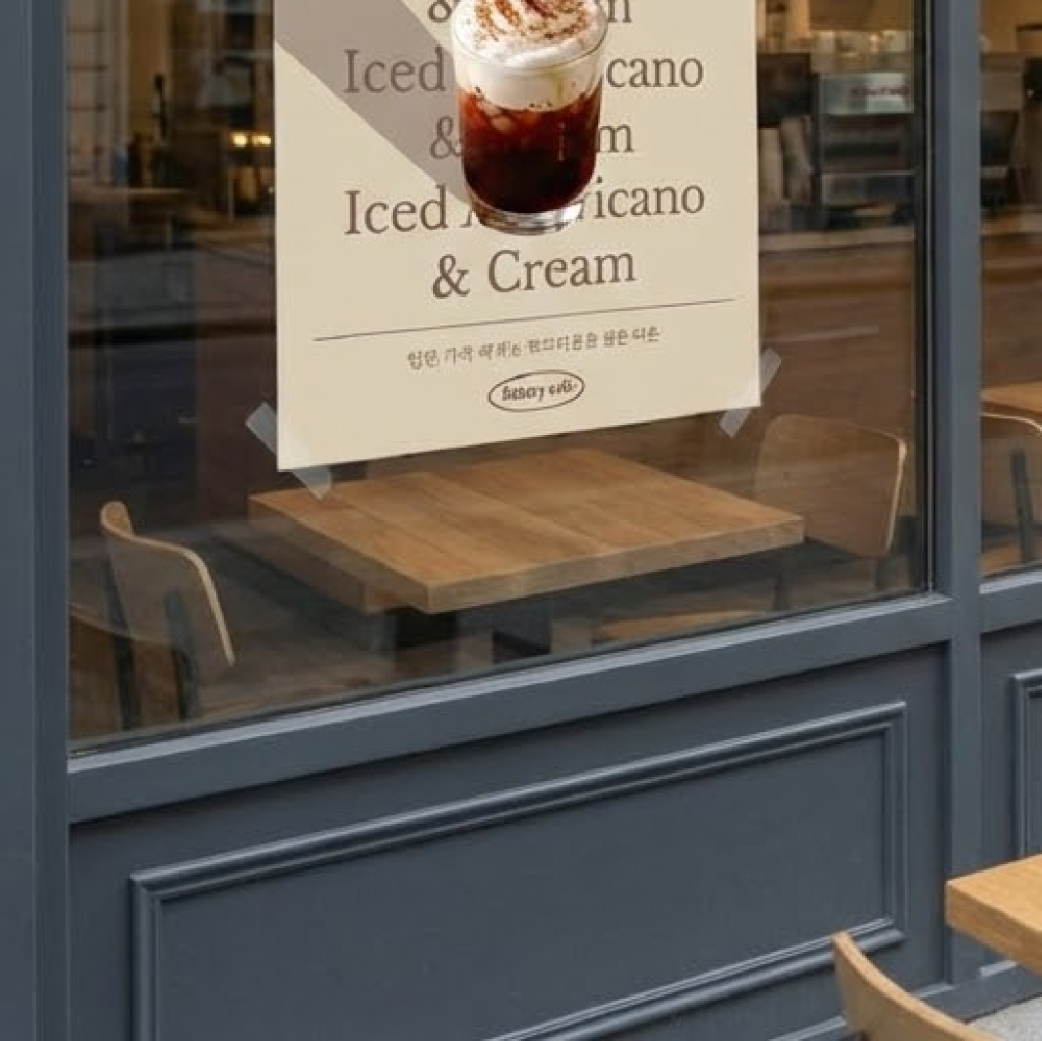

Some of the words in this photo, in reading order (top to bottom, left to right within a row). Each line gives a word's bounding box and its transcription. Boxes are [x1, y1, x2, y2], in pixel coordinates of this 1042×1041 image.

[344, 46, 446, 94] Iced
[344, 184, 447, 236] Iced
[432, 254, 471, 300] &
[487, 249, 637, 294] Cream
